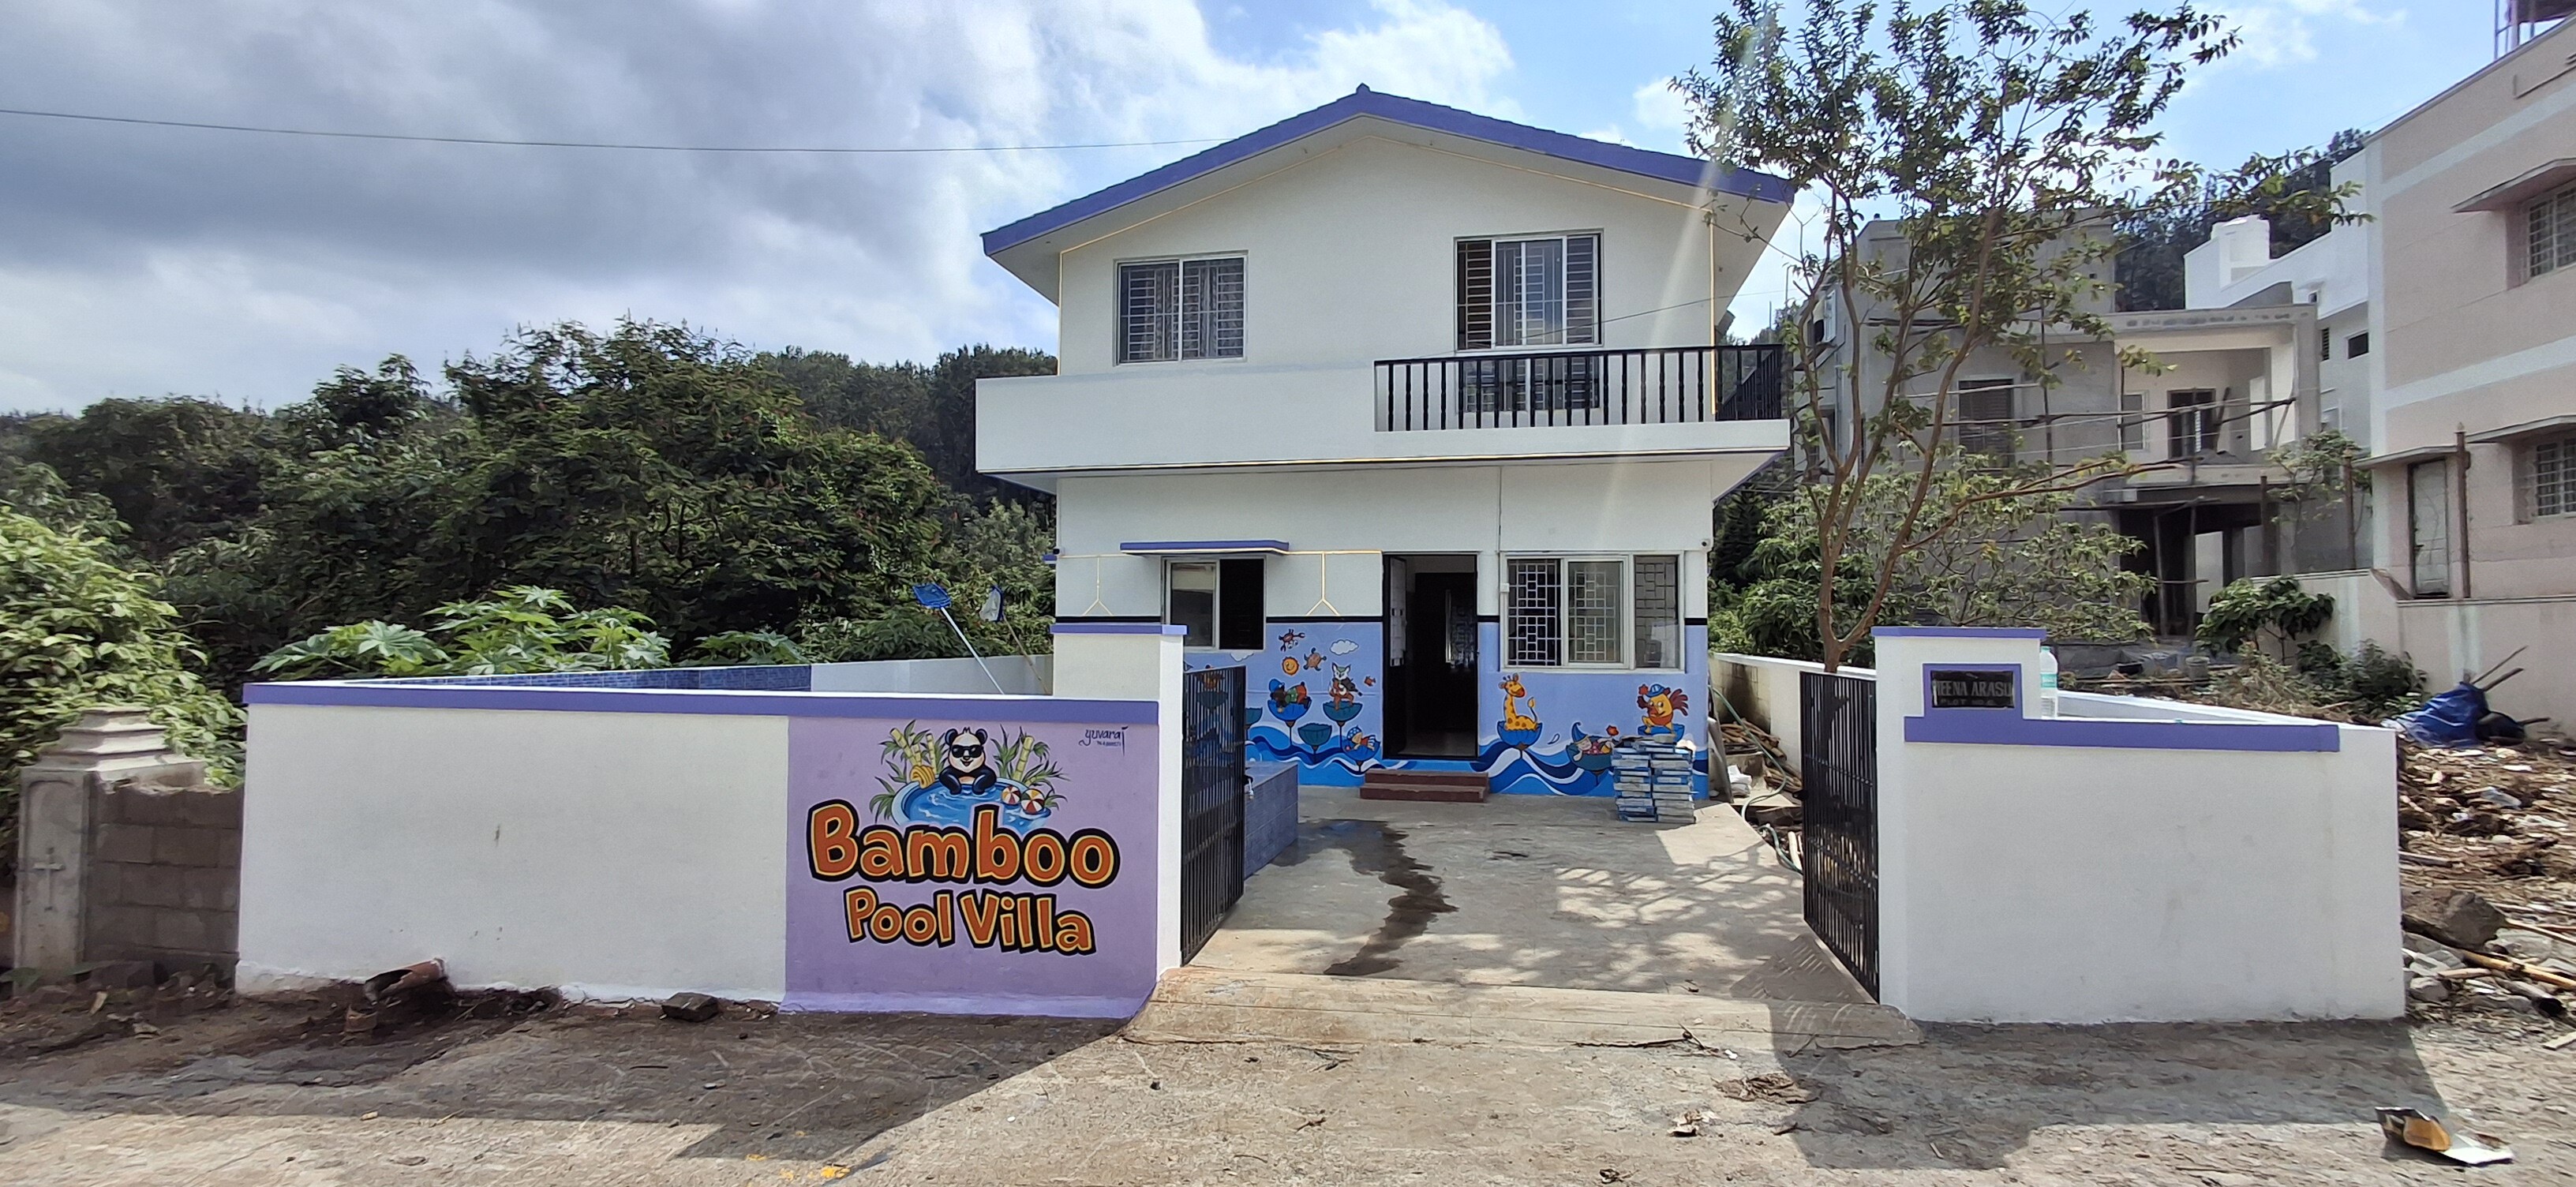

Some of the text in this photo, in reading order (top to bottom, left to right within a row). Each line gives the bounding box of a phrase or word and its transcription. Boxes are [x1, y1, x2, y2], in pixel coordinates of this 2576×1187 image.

[1078, 725, 1129, 756] yuvaraj
[807, 799, 1121, 889] Bamboo
[844, 886, 1096, 956] Pool Villa
